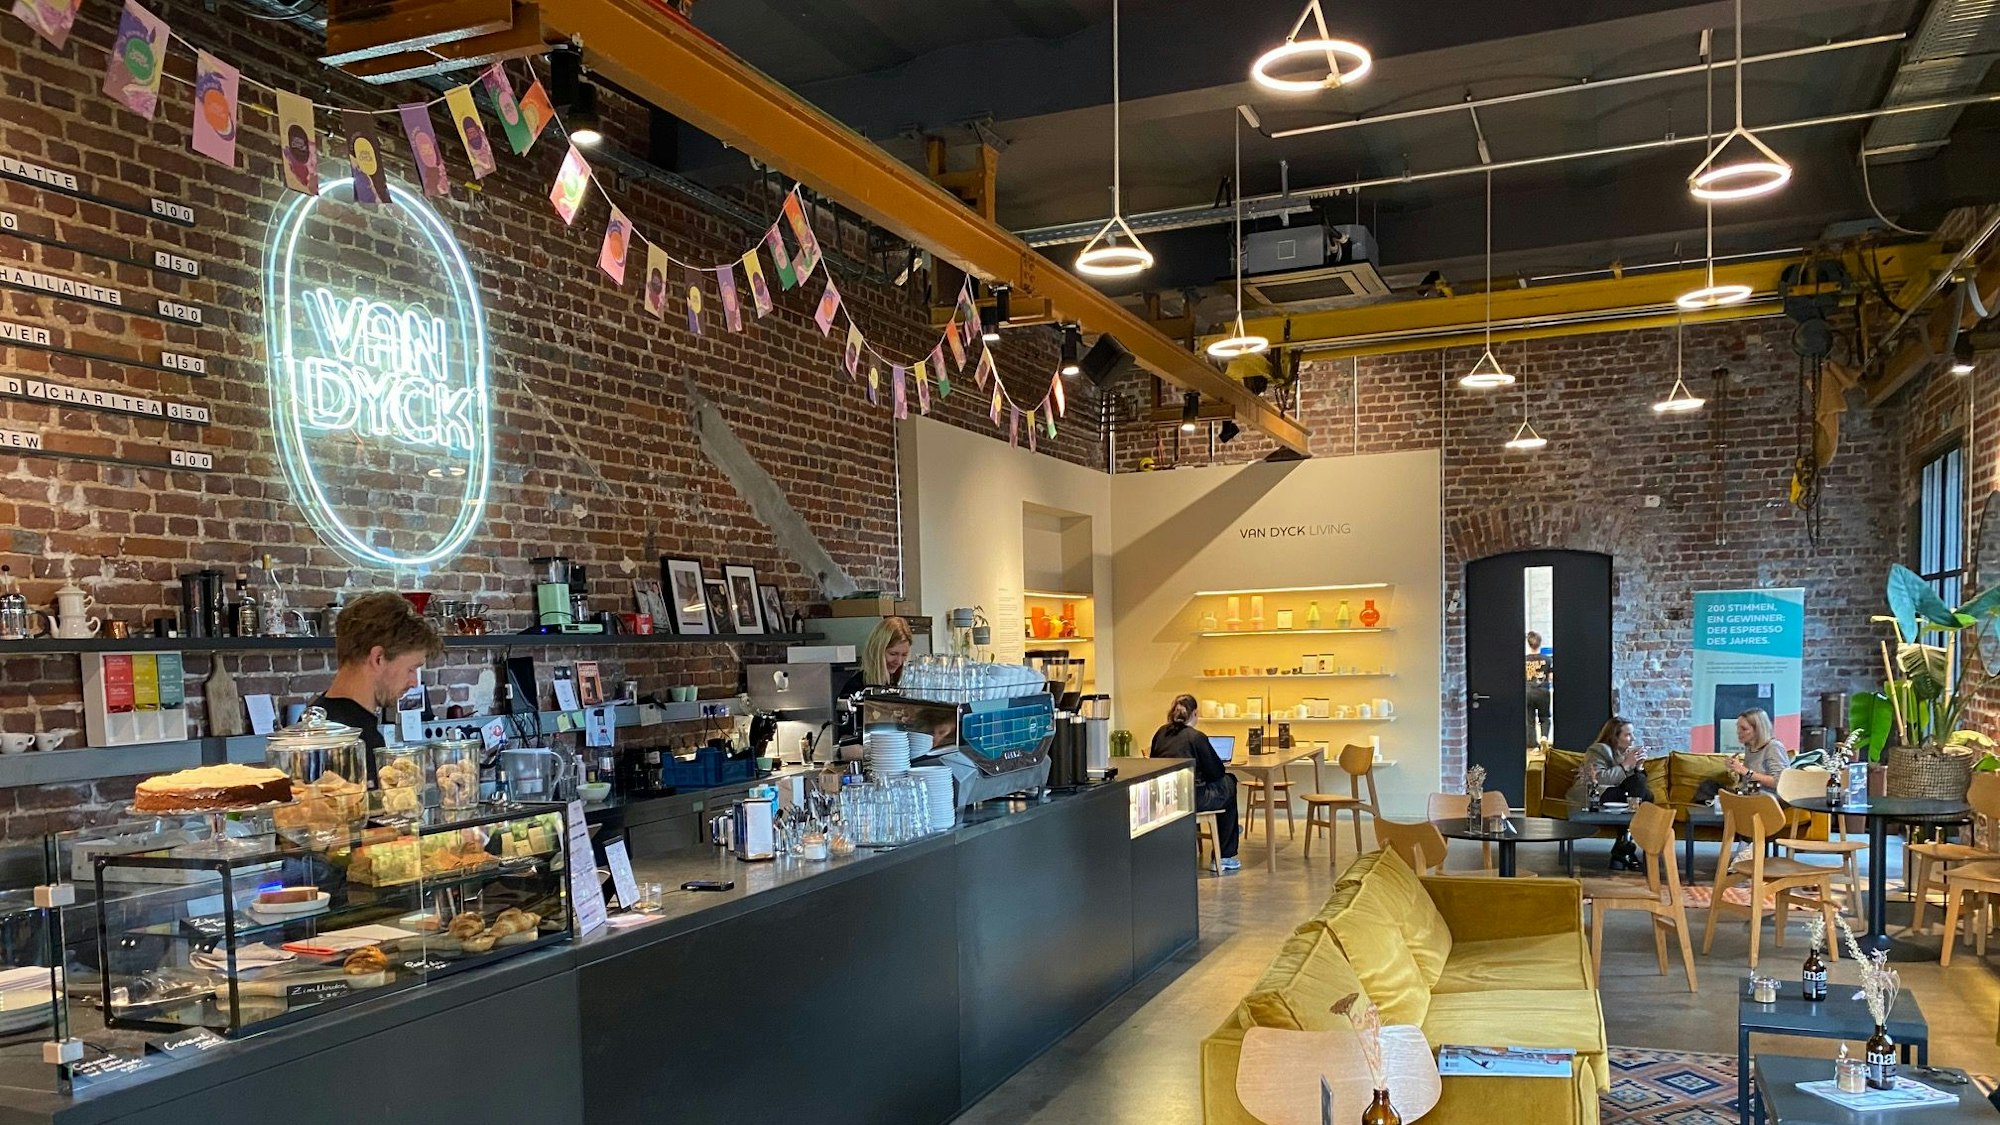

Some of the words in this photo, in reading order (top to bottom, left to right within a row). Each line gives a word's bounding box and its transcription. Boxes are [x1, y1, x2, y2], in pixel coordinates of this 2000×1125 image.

[3, 158, 75, 188] LATTE
[156, 202, 190, 220] 500
[160, 255, 195, 273] 350
[163, 303, 198, 321] 420
[306, 287, 447, 382] VAN
[4, 325, 47, 343] VER
[166, 355, 202, 371] 450
[303, 355, 475, 451] DYCK
[171, 406, 206, 420] 350
[175, 453, 209, 467] 400
[1240, 528, 1266, 538] VAN
[1270, 526, 1306, 538] DYCK
[1309, 523, 1351, 536] LIVING
[1707, 604, 1725, 613] 200
[1707, 615, 1724, 623] EIN
[1726, 614, 1786, 623] GEWINNER:
[1707, 626, 1728, 634] DER
[1730, 625, 1783, 634] ESPRESSO
[1707, 637, 1727, 645] DES
[1728, 636, 1771, 645] JAHRES.
